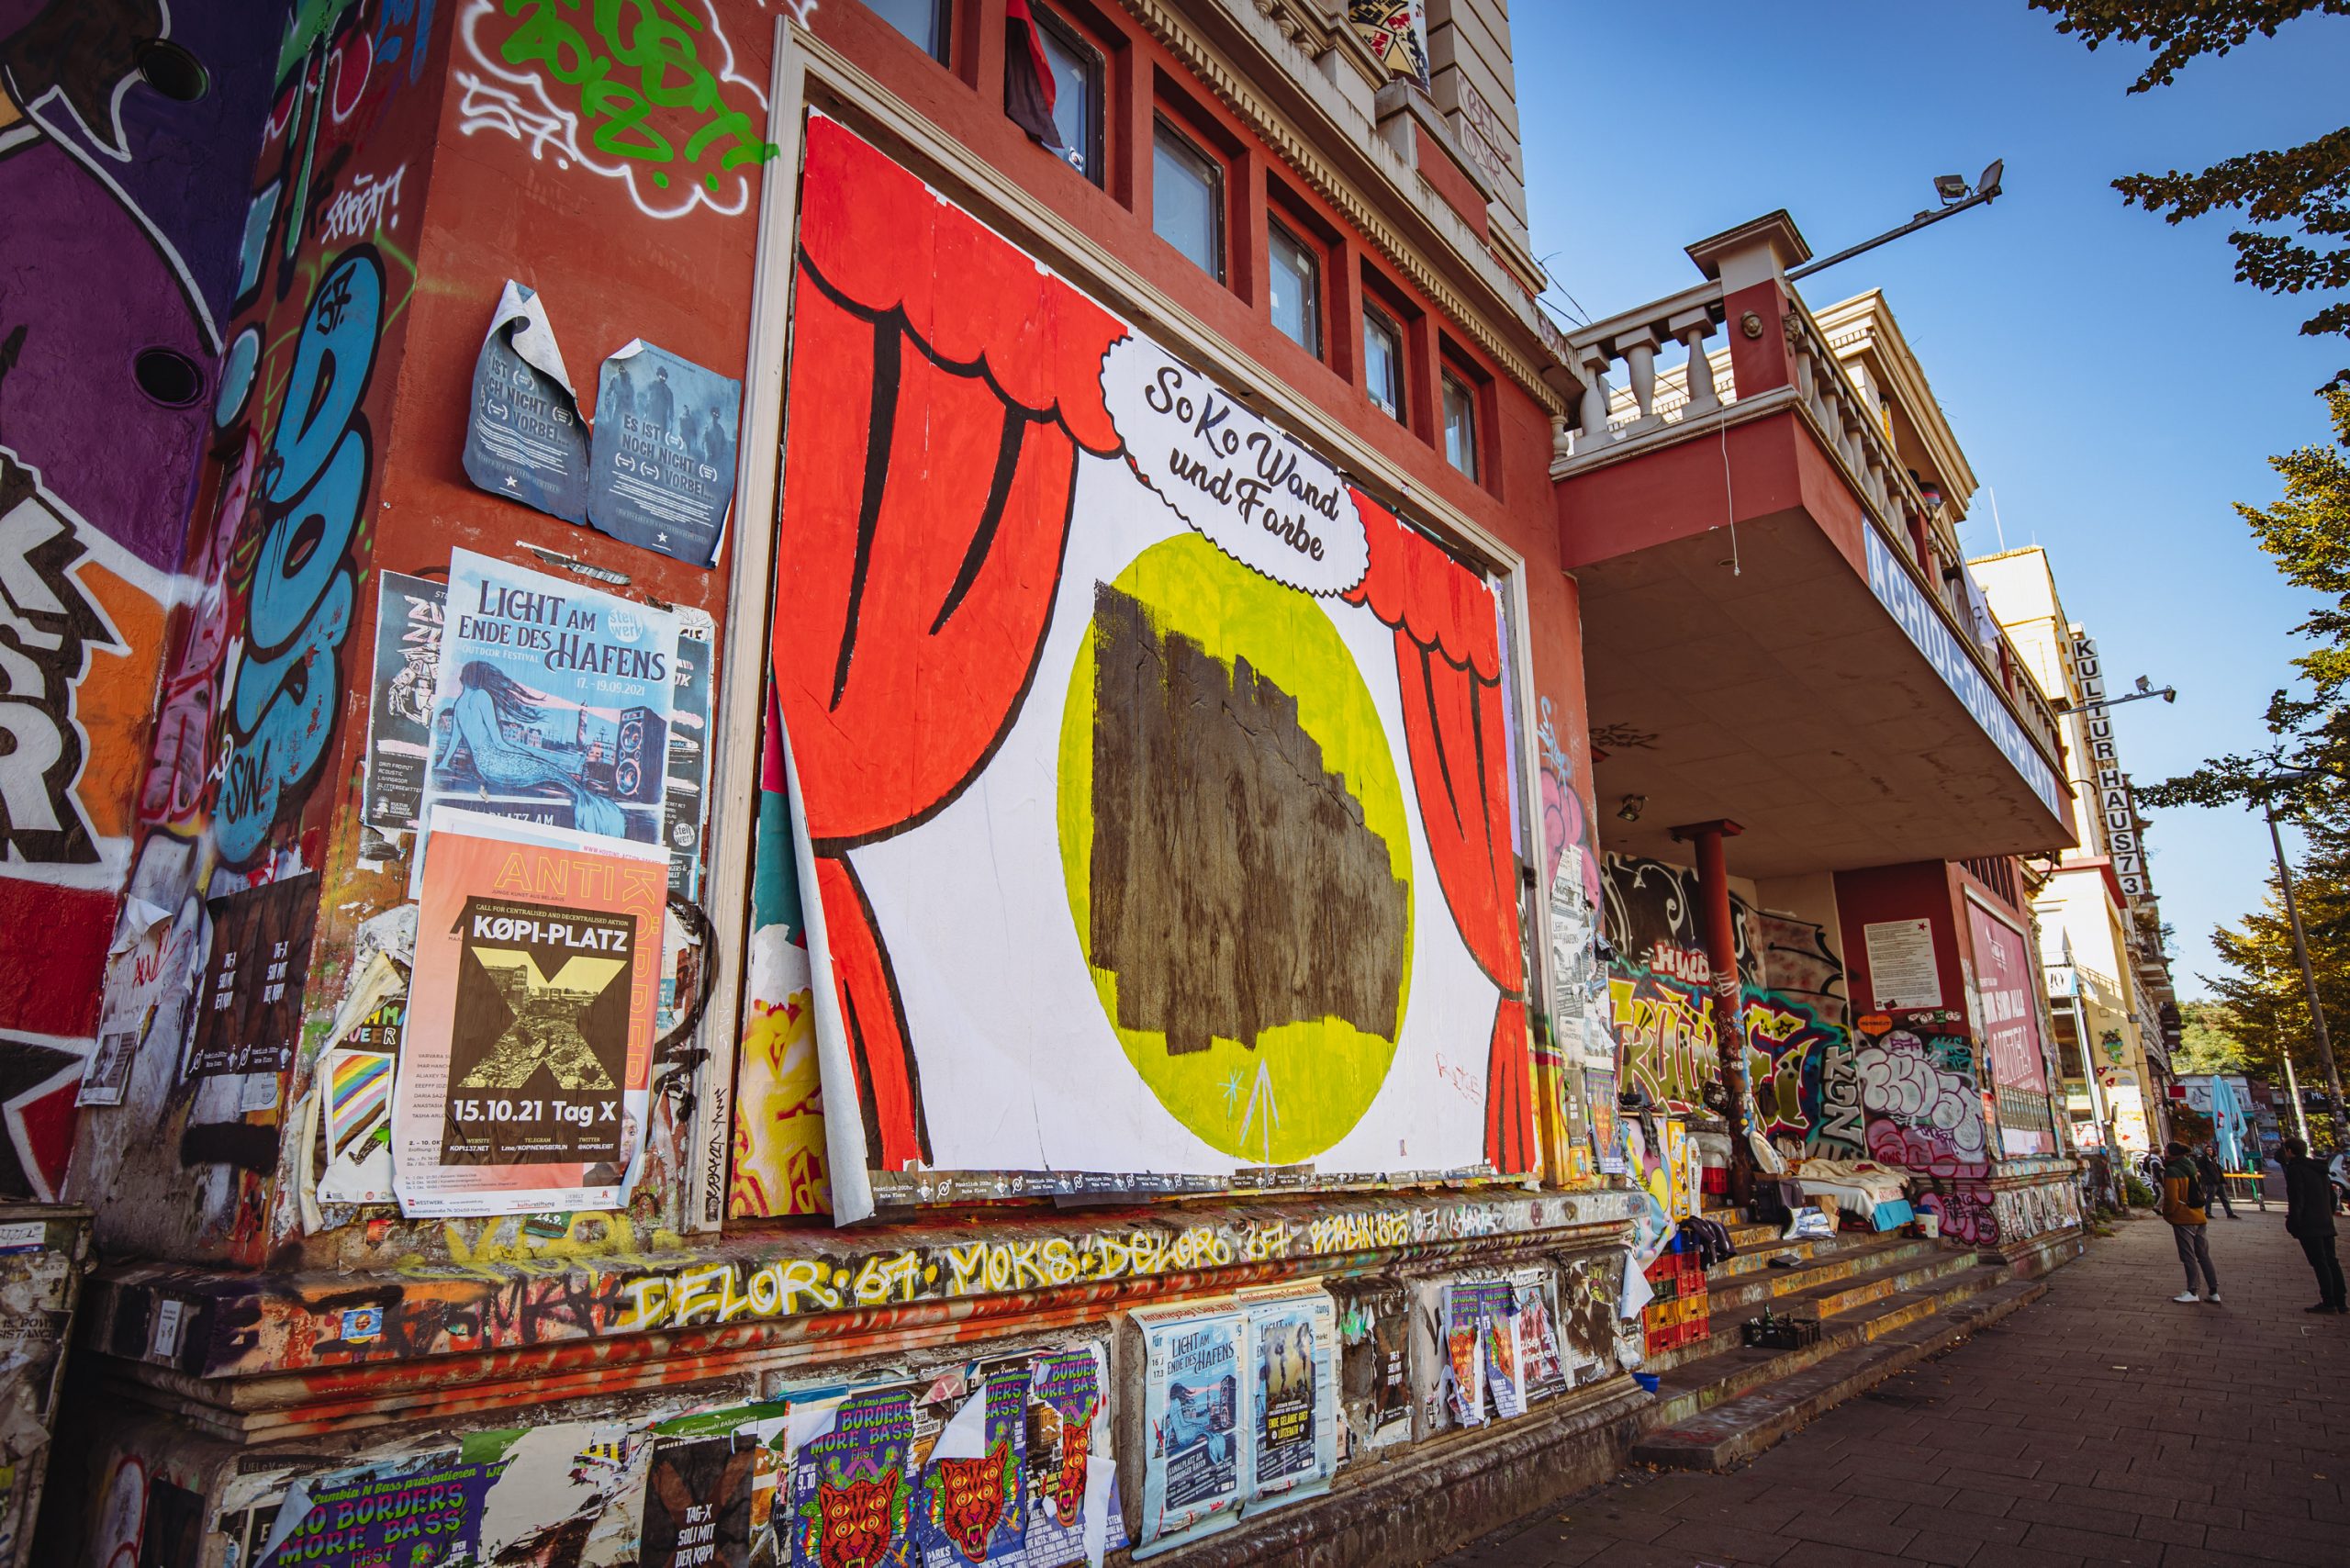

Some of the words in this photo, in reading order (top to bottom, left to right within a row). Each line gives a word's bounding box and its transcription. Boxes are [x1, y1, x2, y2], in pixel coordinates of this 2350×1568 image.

[485, 370, 503, 396] OCH
[507, 386, 548, 415] NICHT
[623, 414, 638, 433] ES
[642, 419, 661, 442] IST
[621, 432, 655, 459] NOCH
[658, 447, 695, 475] NICHT
[1169, 448, 1233, 505] und
[1236, 477, 1325, 562] Farbe
[477, 579, 565, 627] LICHT
[567, 610, 597, 633] AM
[458, 616, 511, 645] ENDE
[517, 627, 552, 652] DES
[543, 632, 666, 682] HAFENS
[462, 644, 500, 659] OUTDOOR
[502, 649, 540, 664] FESTIVAL
[1870, 532, 2061, 817] ACHIDI-JOHN-PLATZ
[510, 891, 530, 900] KUNST
[476, 903, 492, 912] CALL
[492, 905, 506, 913] FOR
[506, 907, 547, 919] CENTRALISED
[548, 912, 562, 920] AND
[562, 913, 608, 924] DECENTRALISED
[607, 918, 630, 927] AKTION
[473, 915, 628, 952] KØPI-PLATZ
[348, 1026, 396, 1046] UEER
[453, 1100, 543, 1122] 15.10.21
[552, 1101, 594, 1128] Tag
[598, 1101, 618, 1122] X
[1168, 1358, 1185, 1375] ENDE
[1184, 1355, 1197, 1370] DES
[1194, 1341, 1235, 1374] HAFENS
[1172, 1332, 1199, 1359] LICHT
[1200, 1334, 1210, 1347] AM
[987, 1382, 1023, 1406] DERS
[842, 1401, 914, 1432] BORDERS
[811, 1430, 860, 1455] MORE
[869, 1422, 914, 1445] BASS
[336, 1483, 464, 1530] BORDERS
[686, 1504, 712, 1525] TAG-X
[278, 1526, 367, 1567] MORE
[383, 1509, 462, 1544] BASS
[699, 1522, 716, 1542] MIT
